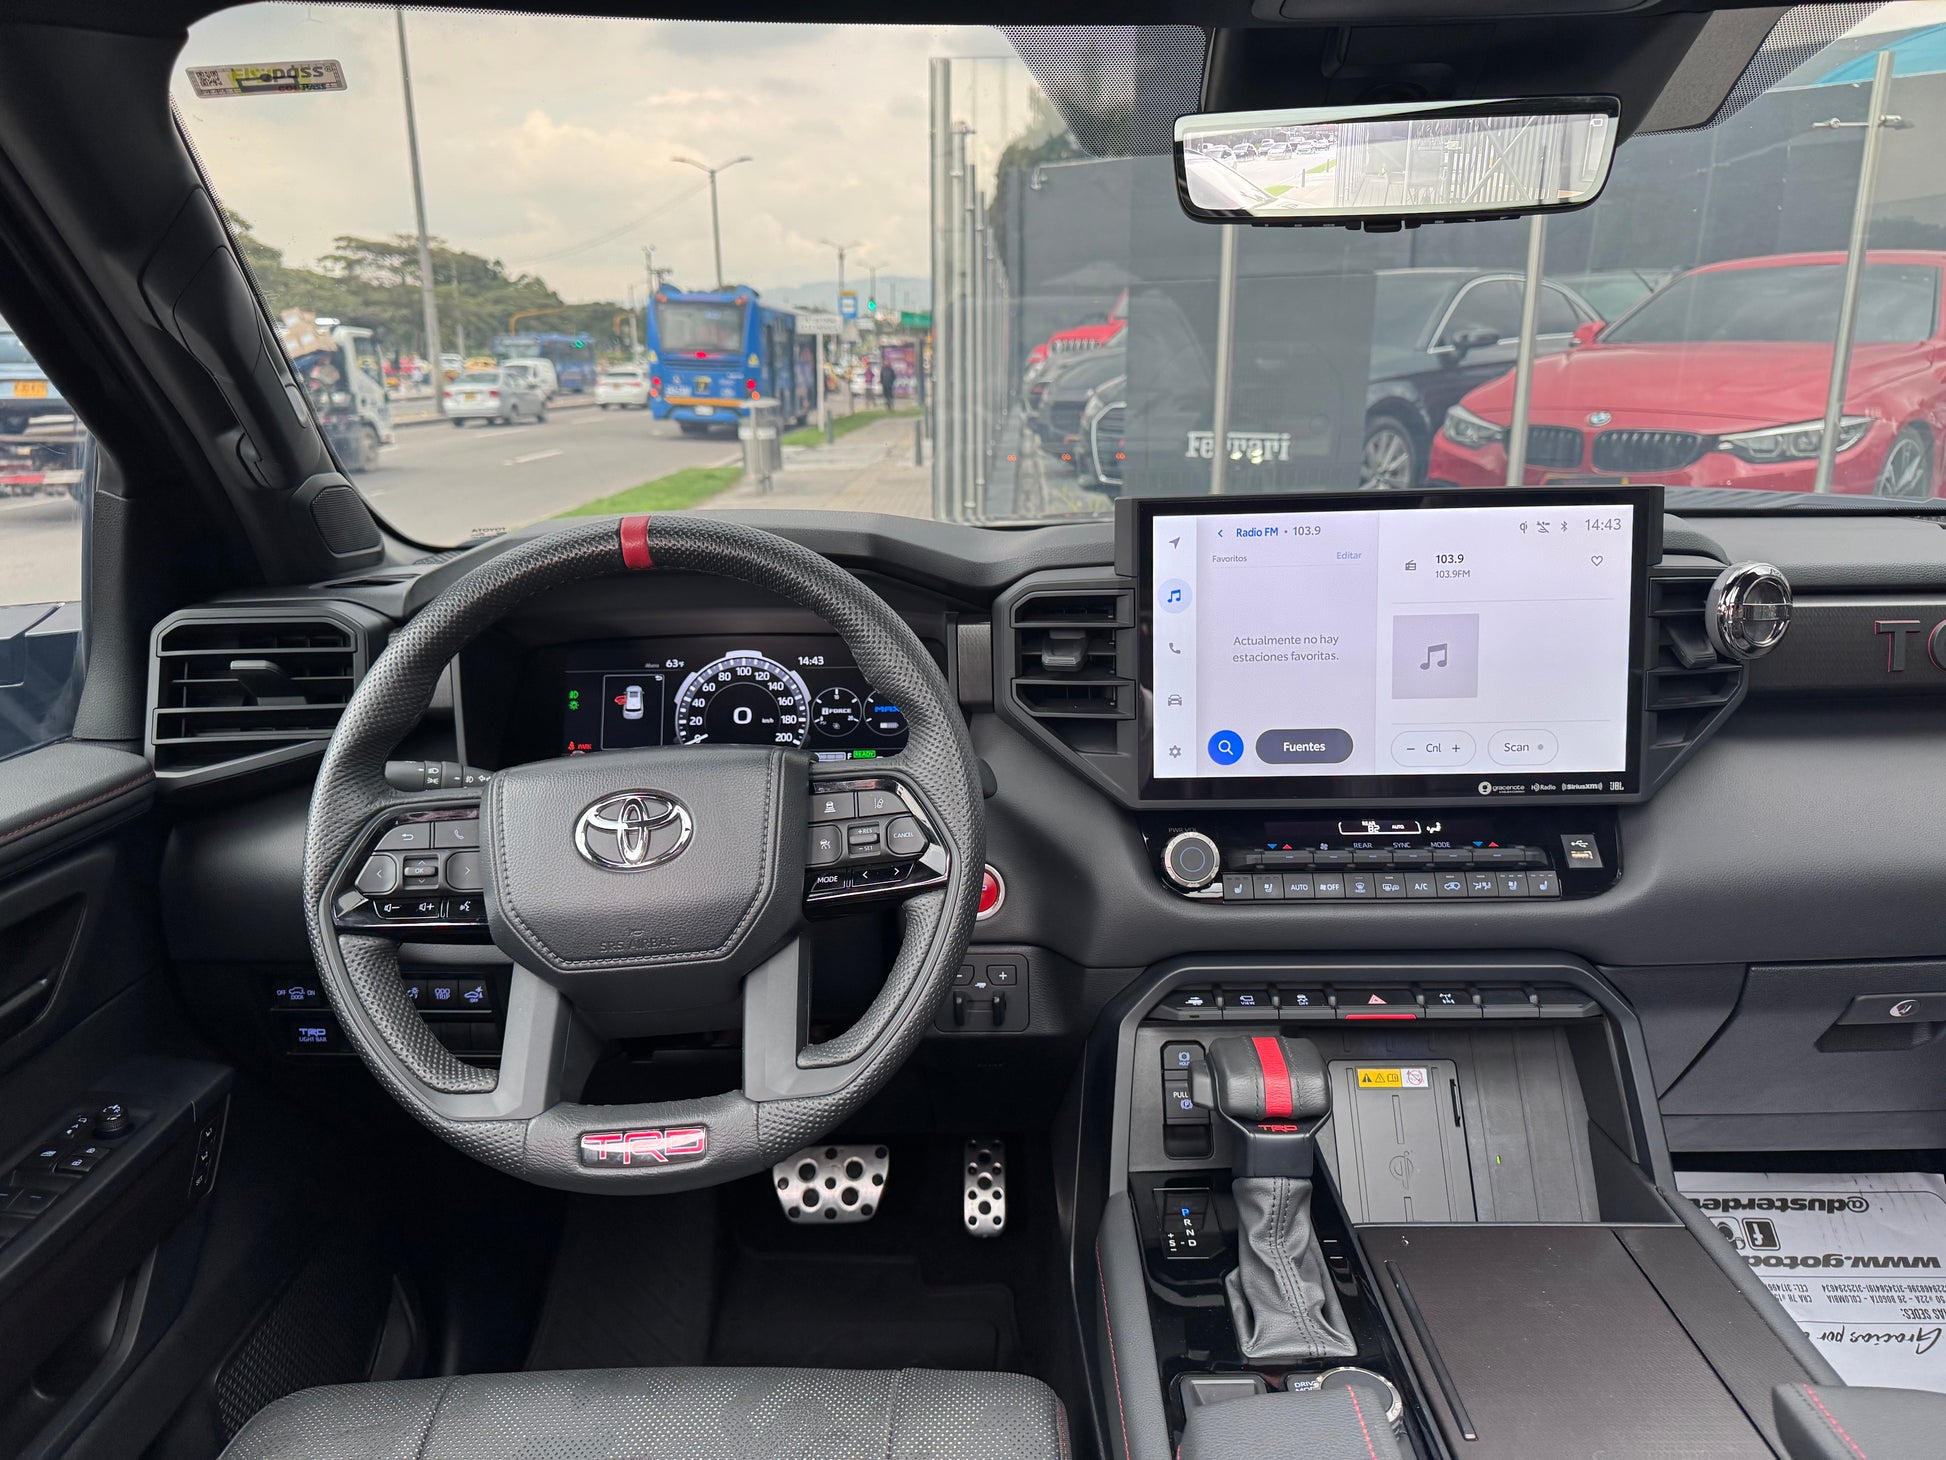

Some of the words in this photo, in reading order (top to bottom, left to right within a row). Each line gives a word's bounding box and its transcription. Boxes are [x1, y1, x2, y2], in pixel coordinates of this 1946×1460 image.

[1184, 431, 1291, 461] Ferari
[1585, 518, 1622, 531] 14:43
[1236, 528, 1263, 538] Radio
[1265, 527, 1279, 537] FM
[1293, 526, 1321, 536] 103.9
[1212, 554, 1247, 563] Favoritos
[1336, 551, 1362, 560] Editar
[1436, 554, 1464, 564] 103.9
[1435, 570, 1471, 579] 103.9FM
[1233, 635, 1301, 646] Actualmente
[1319, 635, 1339, 646] hay
[798, 656, 824, 666] 14:43
[1232, 653, 1289, 663] estaciones
[1291, 651, 1339, 662] favoritas.
[736, 667, 751, 676] 100
[718, 672, 731, 681] 80
[754, 672, 770, 681] 120
[702, 683, 716, 692] 60
[768, 682, 784, 691] 140
[692, 699, 705, 708] 40
[778, 697, 794, 706] 160
[733, 707, 752, 725] 0
[781, 715, 797, 724] 180
[689, 717, 703, 726] 20
[775, 733, 793, 742] 200
[1283, 741, 1326, 752] Fuentes
[1426, 743, 1441, 752] Cnl
[1504, 742, 1530, 752] Scan
[1610, 782, 1624, 791] JBL
[893, 831, 914, 839] CANCEL
[817, 875, 838, 884] MODE
[1327, 883, 1340, 891] OFF
[299, 1028, 326, 1037] TRD
[1173, 1091, 1189, 1099] PULL
[1258, 1124, 1298, 1132] TRD
[581, 1128, 705, 1165] TRD
[1181, 1208, 1190, 1217] P
[1183, 1218, 1192, 1226] R
[1186, 1228, 1195, 1236] N
[1827, 1294, 1862, 1304] COLOMBIA
[1901, 1308, 1931, 1320] SEDES:
[1817, 1325, 1845, 1342] por
[1850, 1327, 1942, 1354] Gracias
